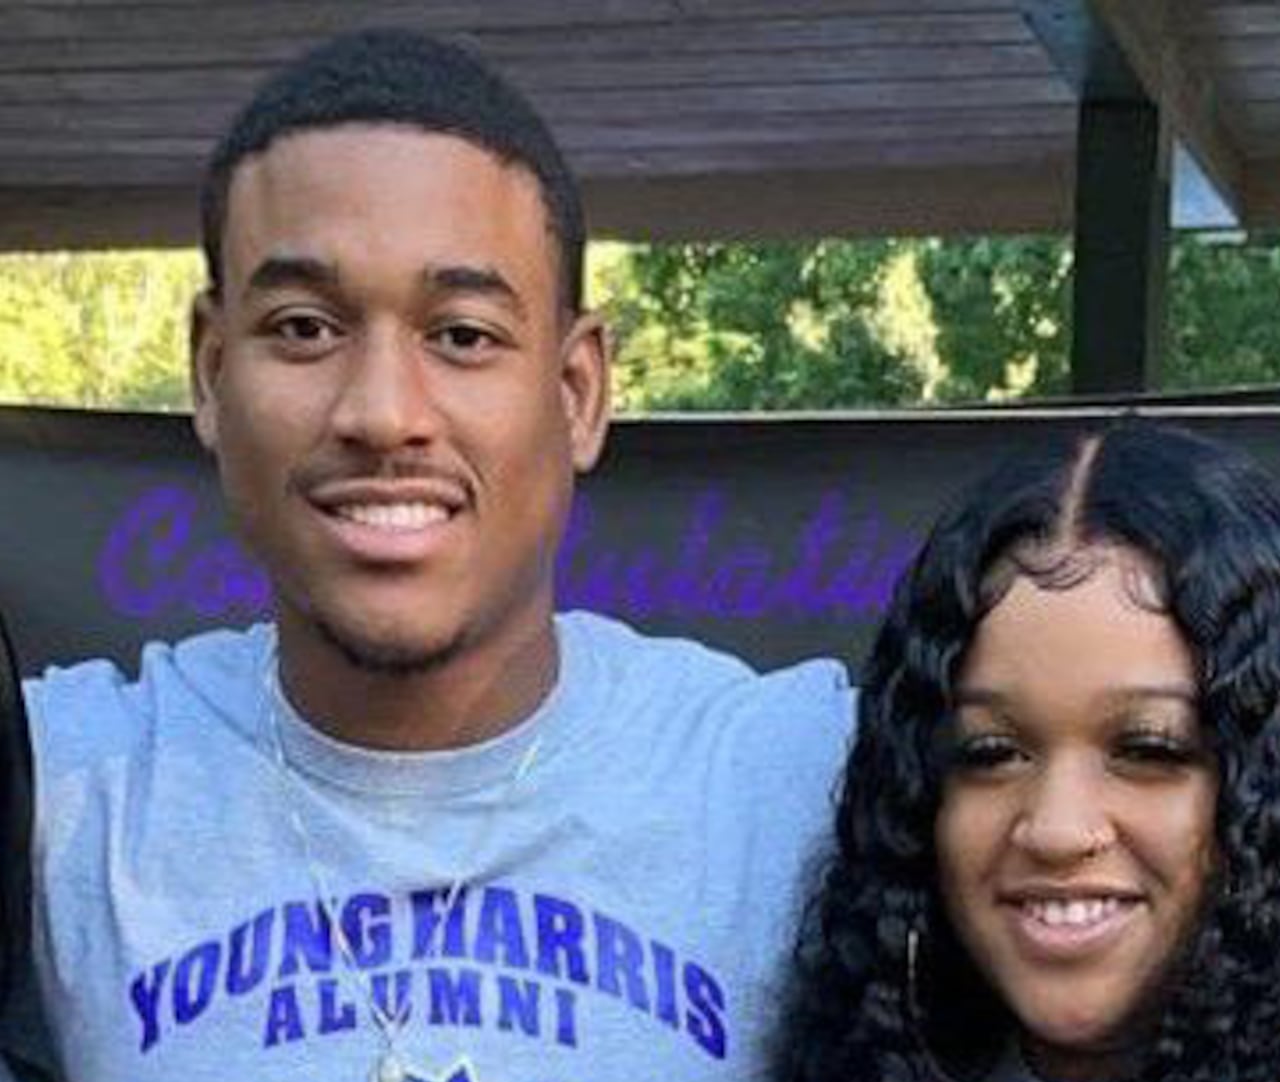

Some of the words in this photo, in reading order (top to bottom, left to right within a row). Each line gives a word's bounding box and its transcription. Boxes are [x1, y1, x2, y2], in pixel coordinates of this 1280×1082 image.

[128, 893, 392, 1055] YOUNG
[411, 885, 727, 1060] HARRIS
[263, 967, 577, 1049] ALUMNI
